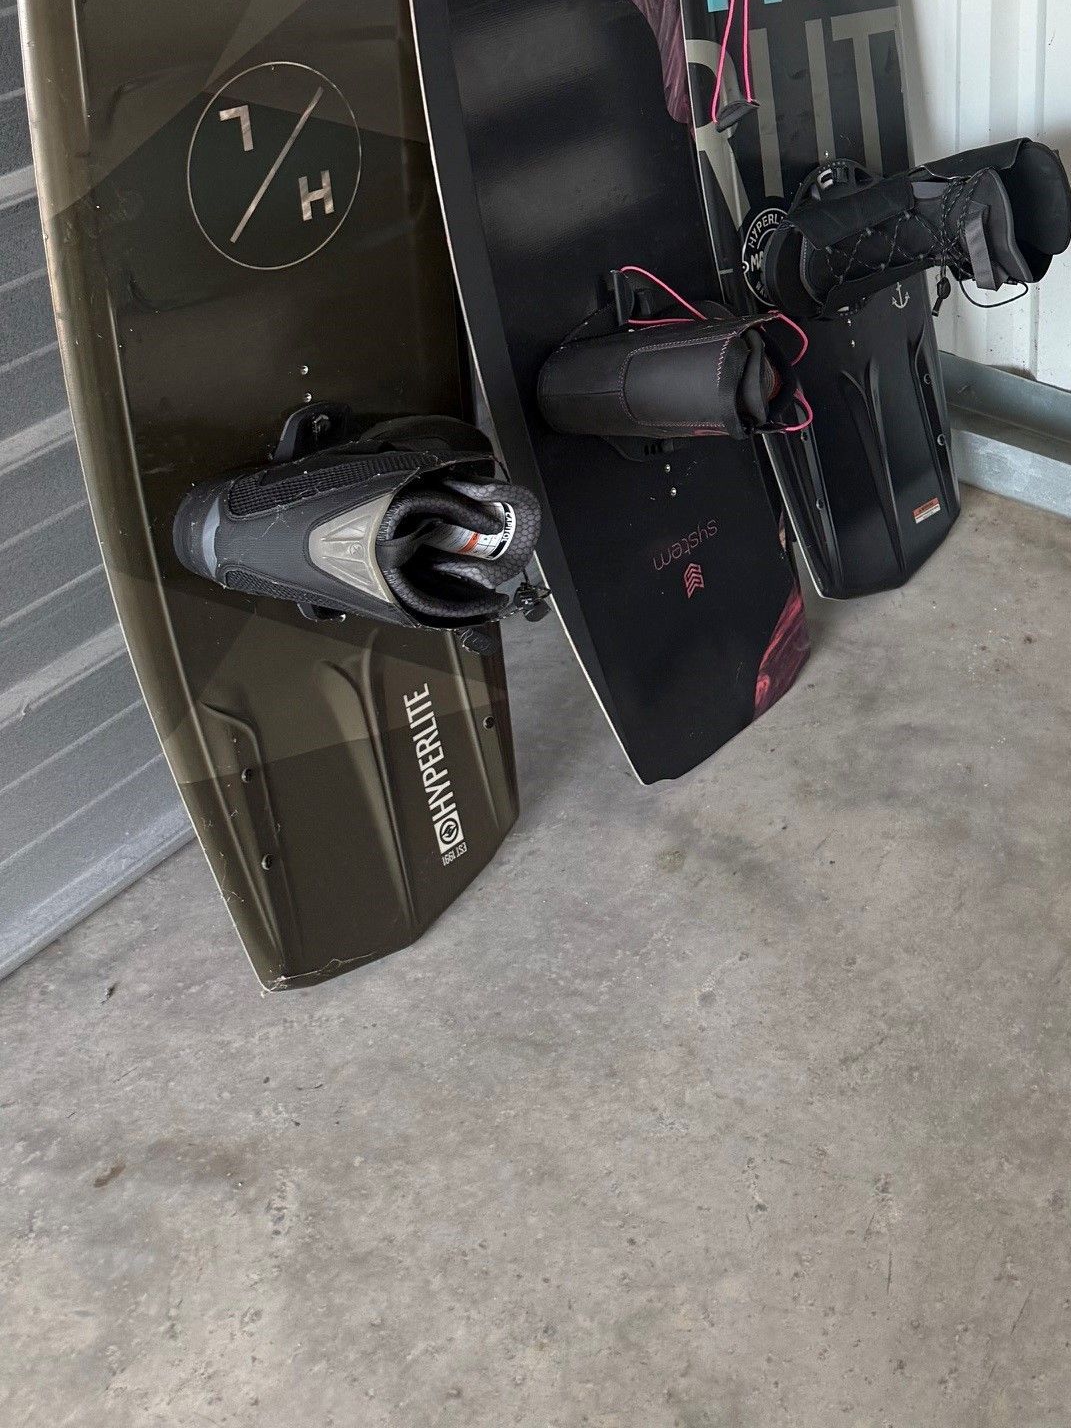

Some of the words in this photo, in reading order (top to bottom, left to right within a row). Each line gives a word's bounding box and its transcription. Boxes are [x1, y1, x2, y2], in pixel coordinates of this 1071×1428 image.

[748, 213, 786, 249] HYPERL
[652, 519, 718, 571] system
[403, 682, 457, 822] HYPERLITE
